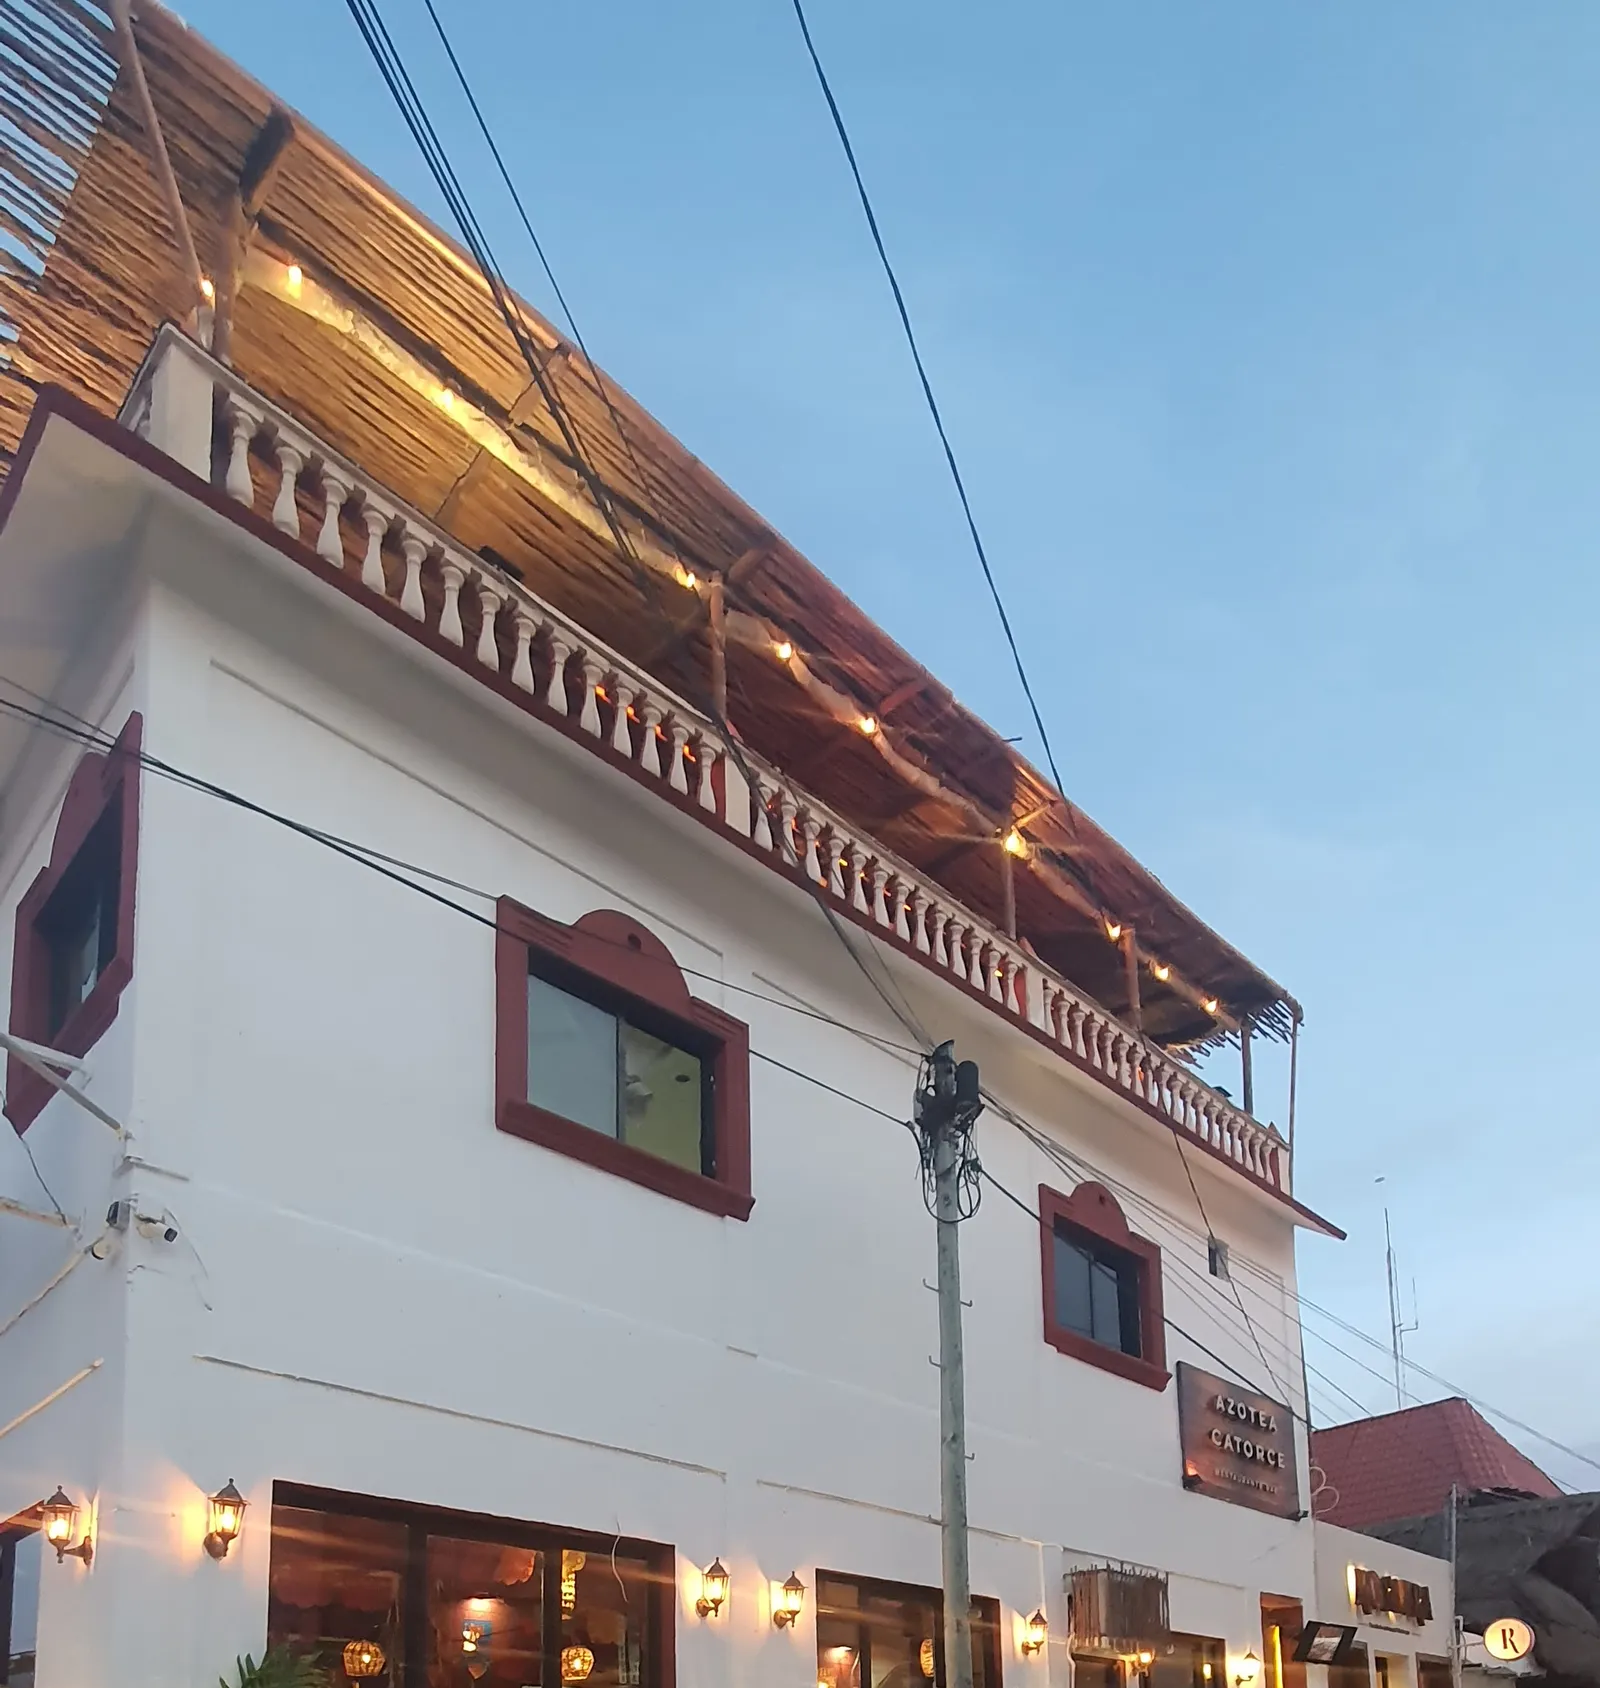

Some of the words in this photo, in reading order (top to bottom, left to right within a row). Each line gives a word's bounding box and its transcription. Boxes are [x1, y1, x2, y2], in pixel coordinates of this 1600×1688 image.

[1216, 1395, 1278, 1435] AZOTEA
[1211, 1428, 1286, 1469] CATORCE
[1501, 1627, 1520, 1654] R
